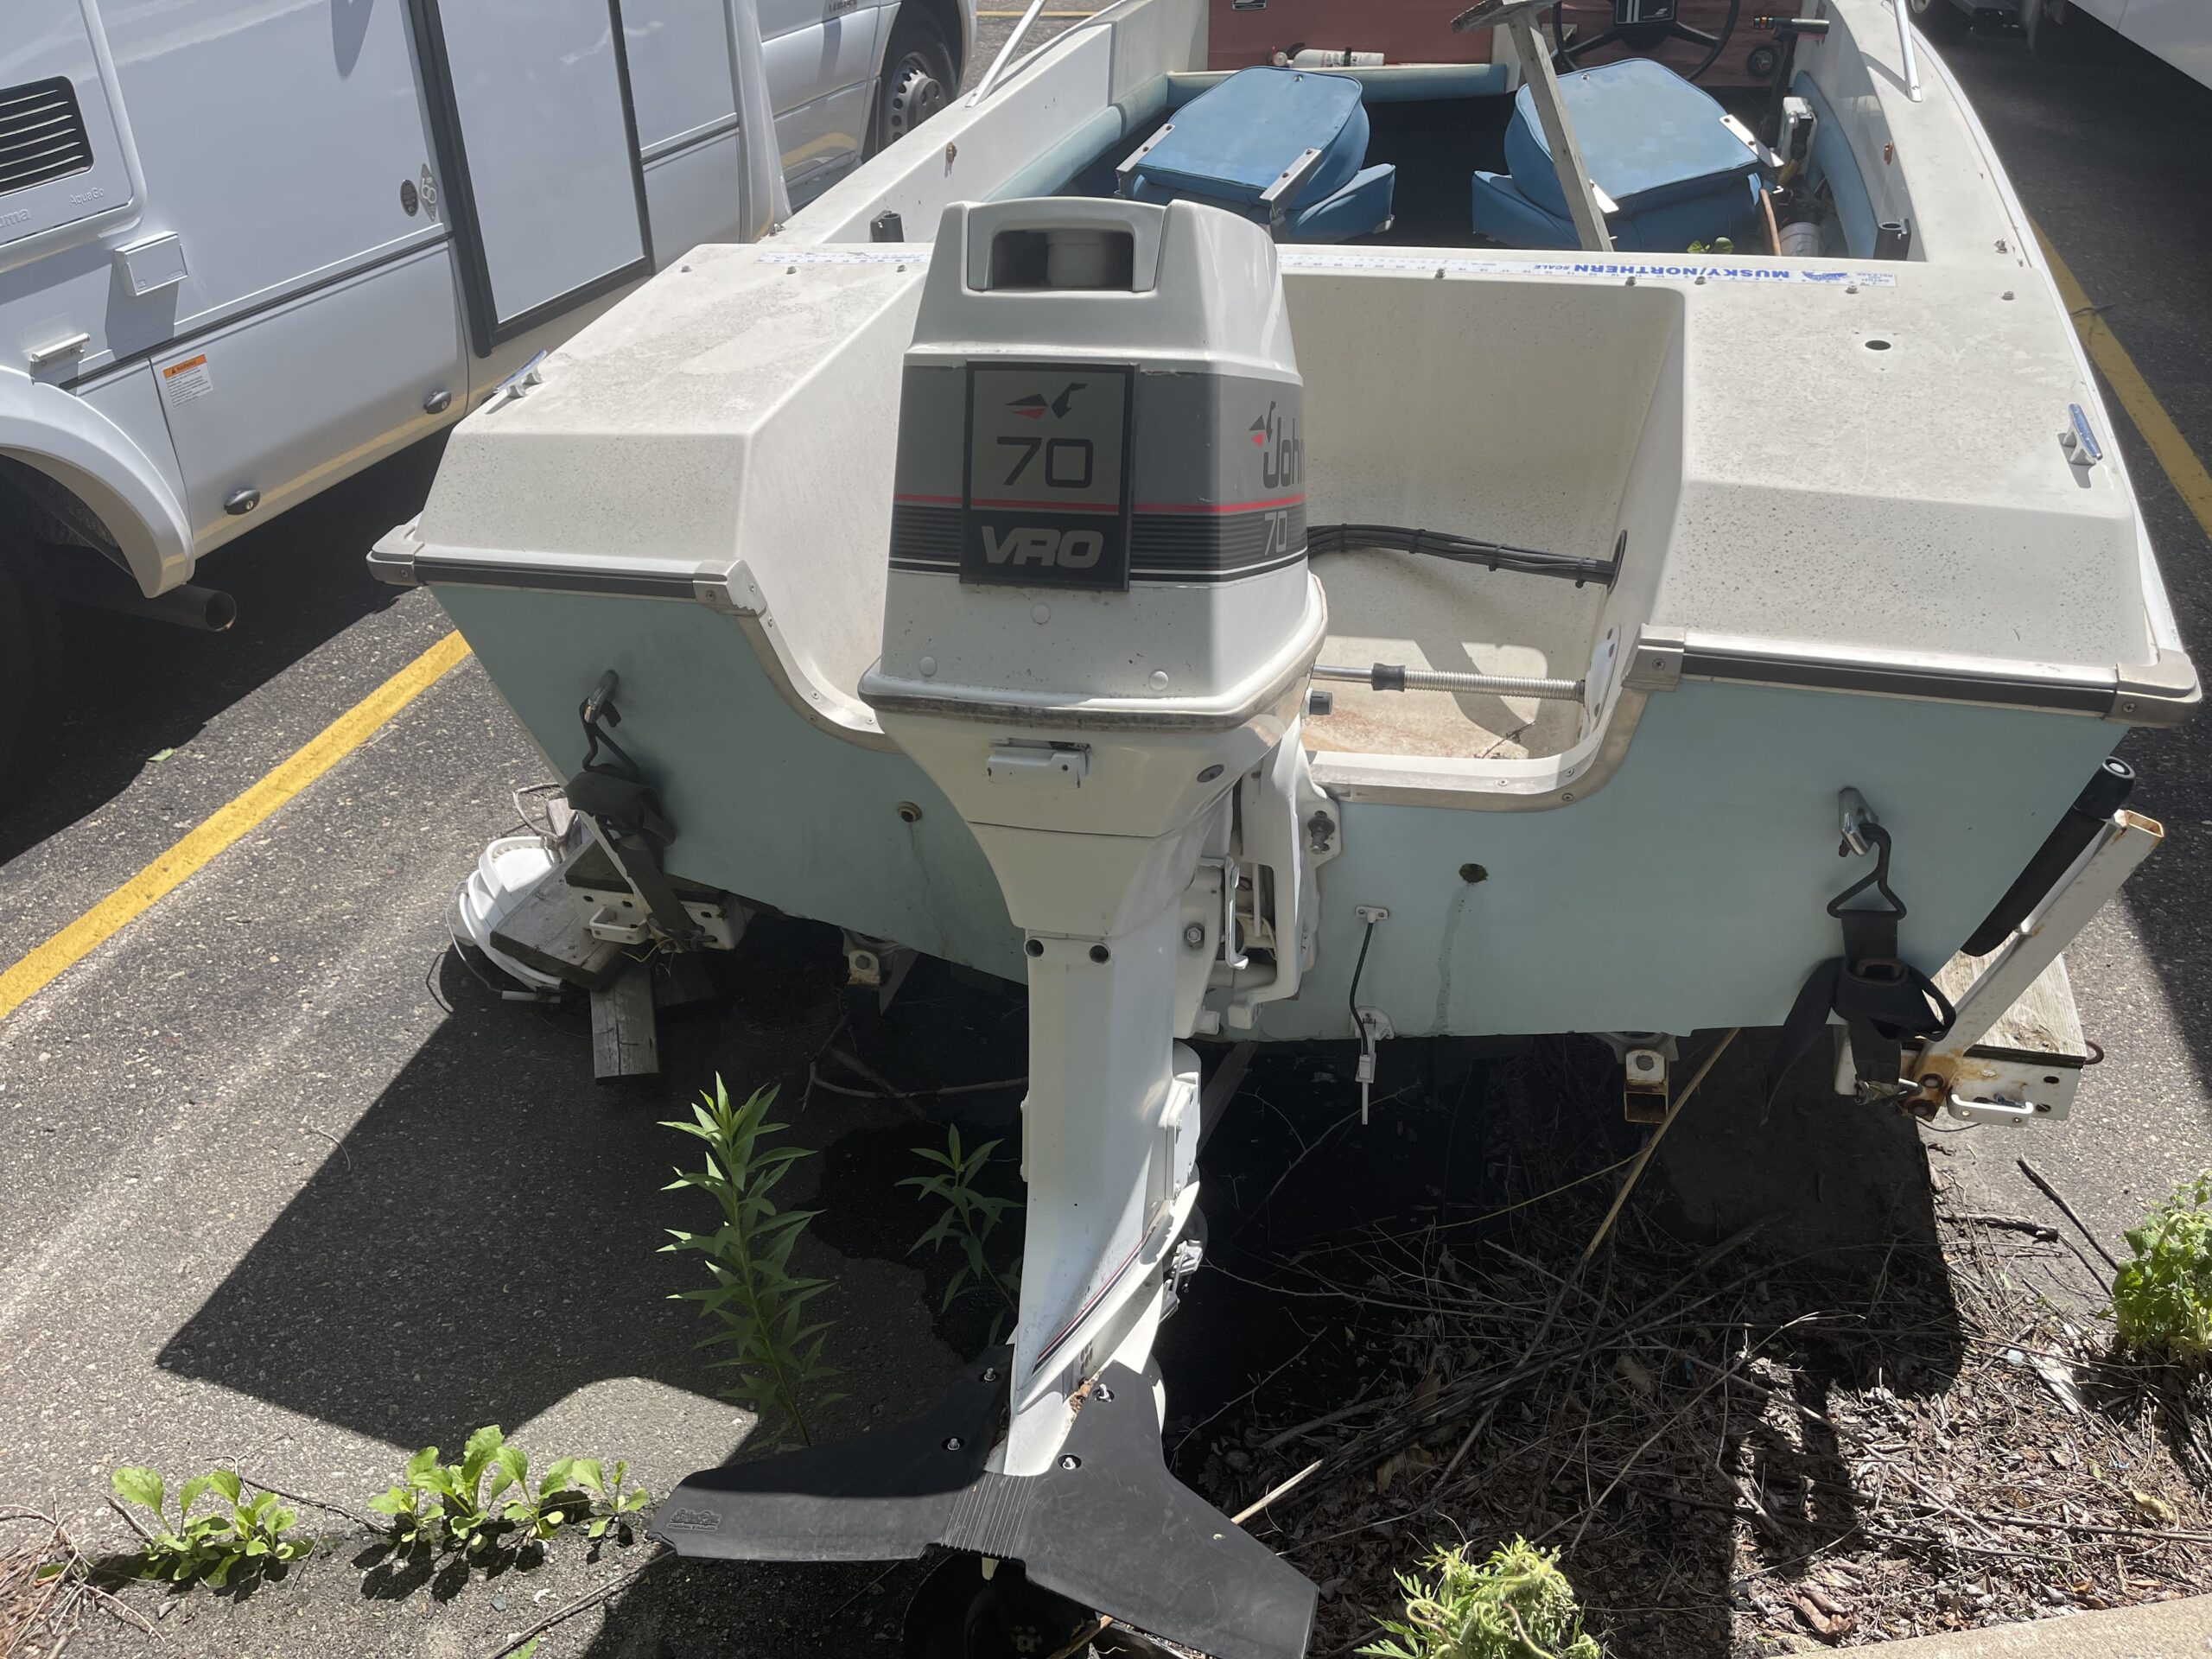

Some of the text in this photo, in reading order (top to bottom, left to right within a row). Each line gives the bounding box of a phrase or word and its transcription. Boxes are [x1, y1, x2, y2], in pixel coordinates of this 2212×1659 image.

[70, 187, 105, 207] AquaGo
[1573, 264, 1790, 278] MUSKY/NORTHERN
[996, 435, 1094, 489] 70
[981, 525, 1104, 569] VRO
[1264, 510, 1287, 556] 70
